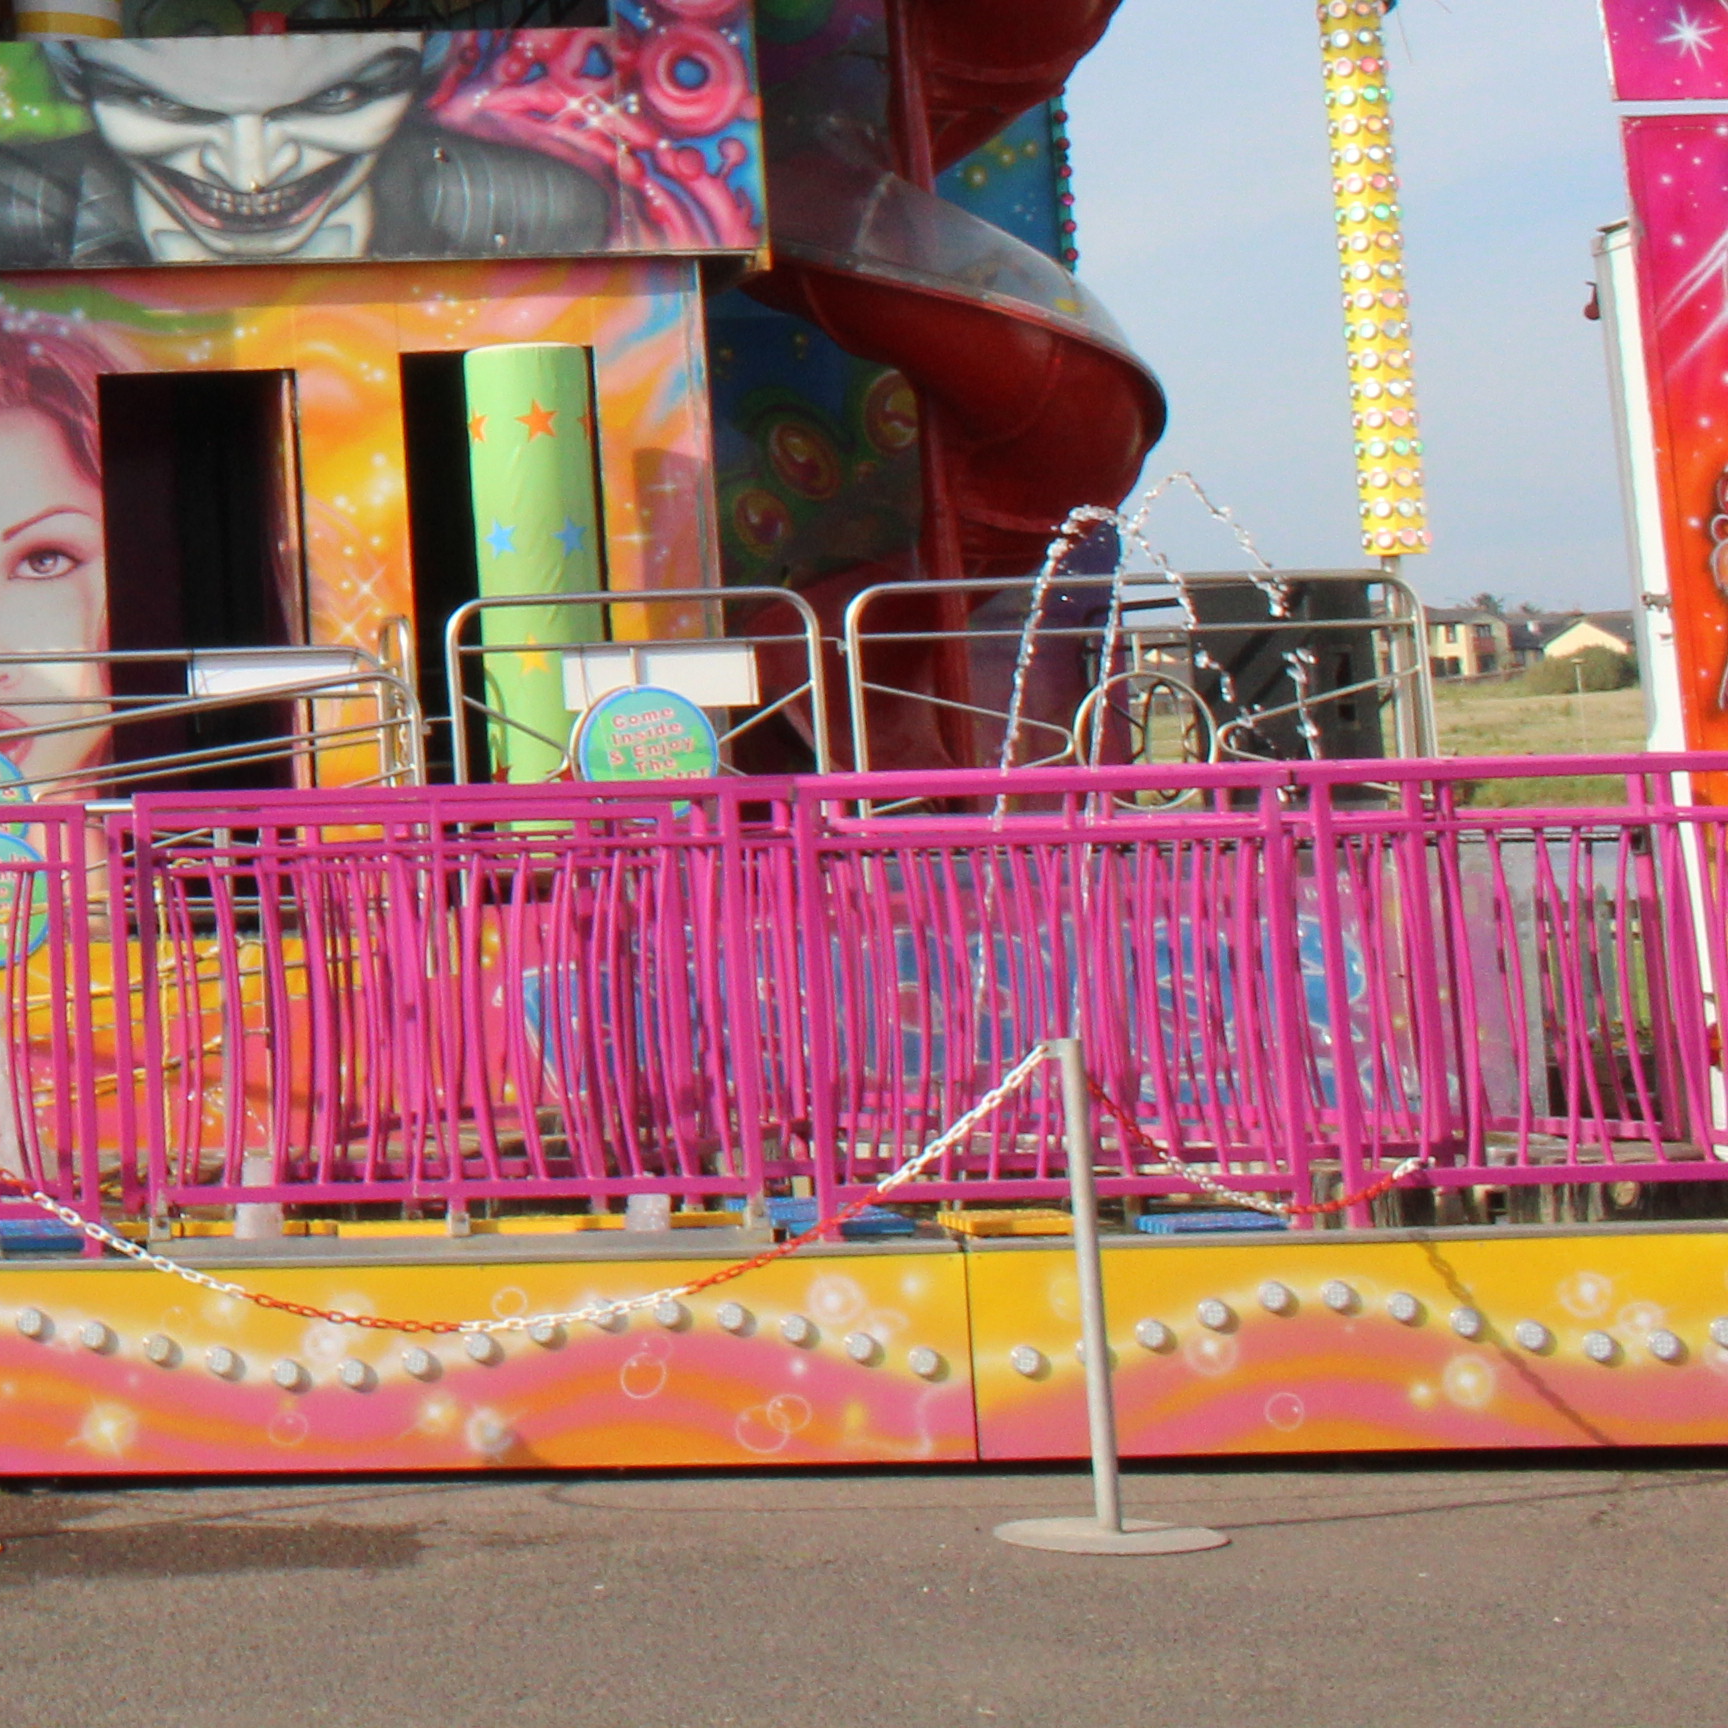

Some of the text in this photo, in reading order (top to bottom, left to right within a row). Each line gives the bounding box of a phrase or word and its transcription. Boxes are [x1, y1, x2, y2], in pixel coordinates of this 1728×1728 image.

[612, 707, 675, 729] Come
[611, 723, 683, 746] Inside
[633, 738, 696, 759] Enjoy
[635, 758, 677, 775] The
